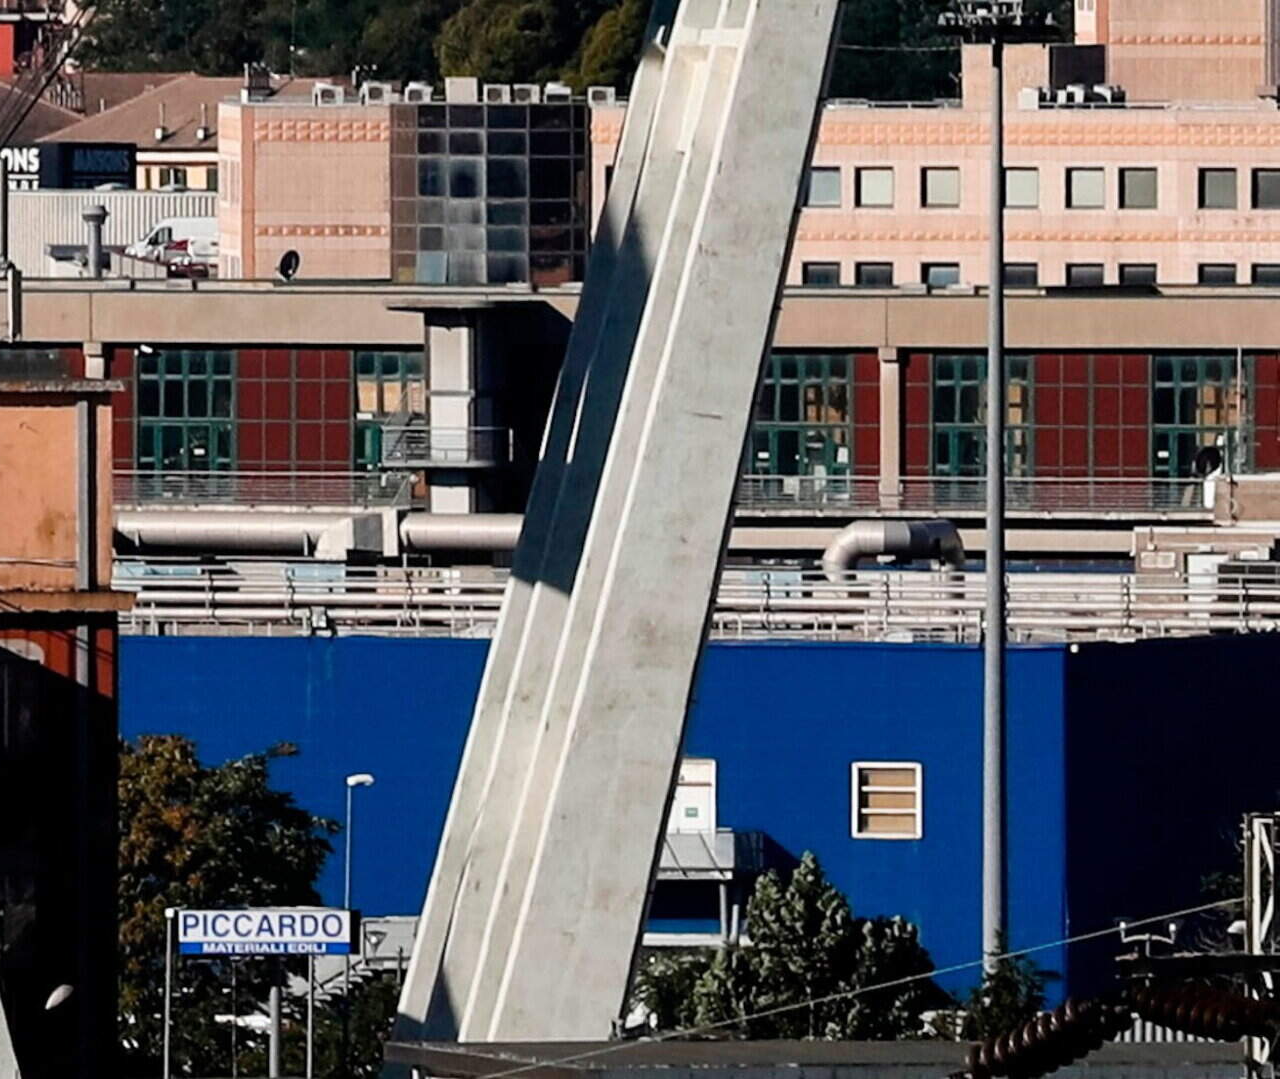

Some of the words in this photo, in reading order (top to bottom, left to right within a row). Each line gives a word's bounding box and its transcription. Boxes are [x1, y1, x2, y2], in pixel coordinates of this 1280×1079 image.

[182, 913, 343, 937] PICCARDO
[202, 943, 283, 954] MATERIALI
[288, 943, 326, 954] EDILI
